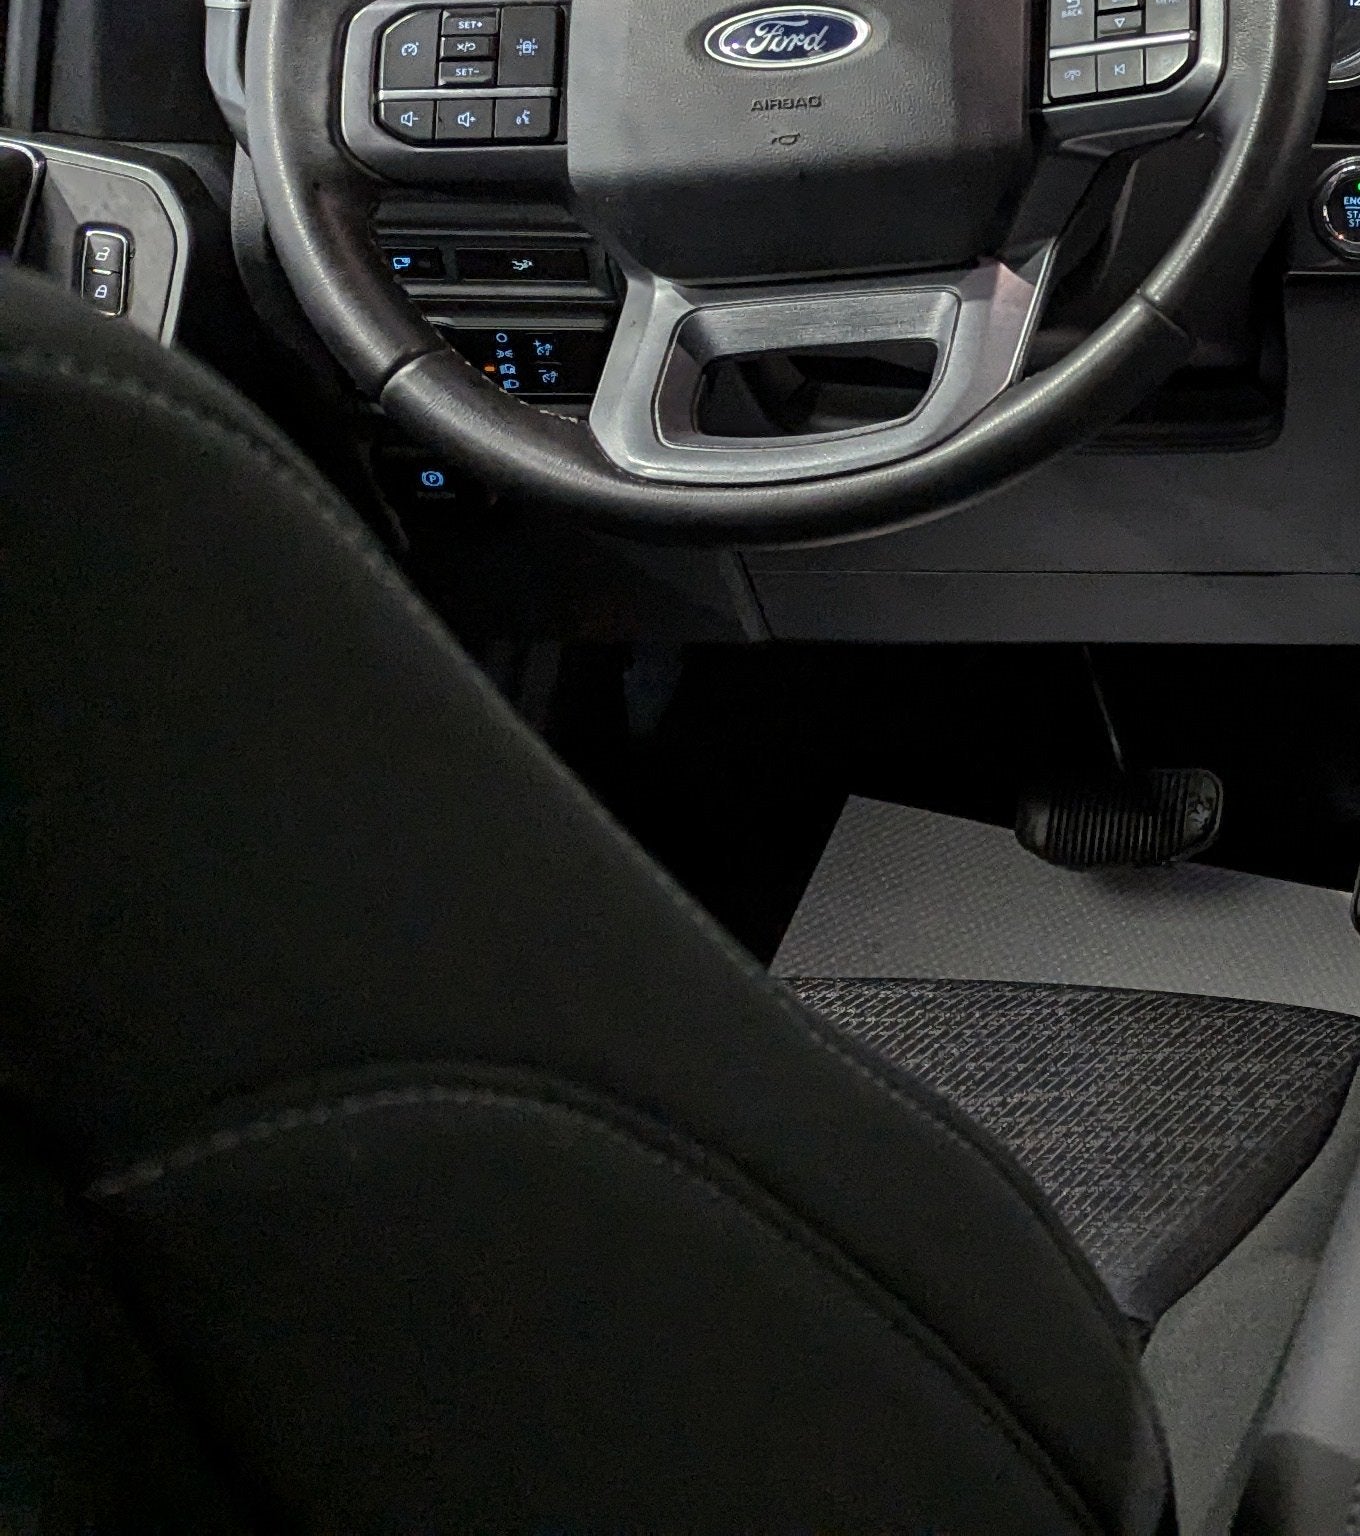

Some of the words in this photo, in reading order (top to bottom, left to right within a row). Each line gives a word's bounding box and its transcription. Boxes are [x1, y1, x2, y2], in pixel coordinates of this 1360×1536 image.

[1061, 9, 1083, 19] BACK
[746, 19, 829, 55] Ford
[750, 95, 823, 112] AIRBAG
